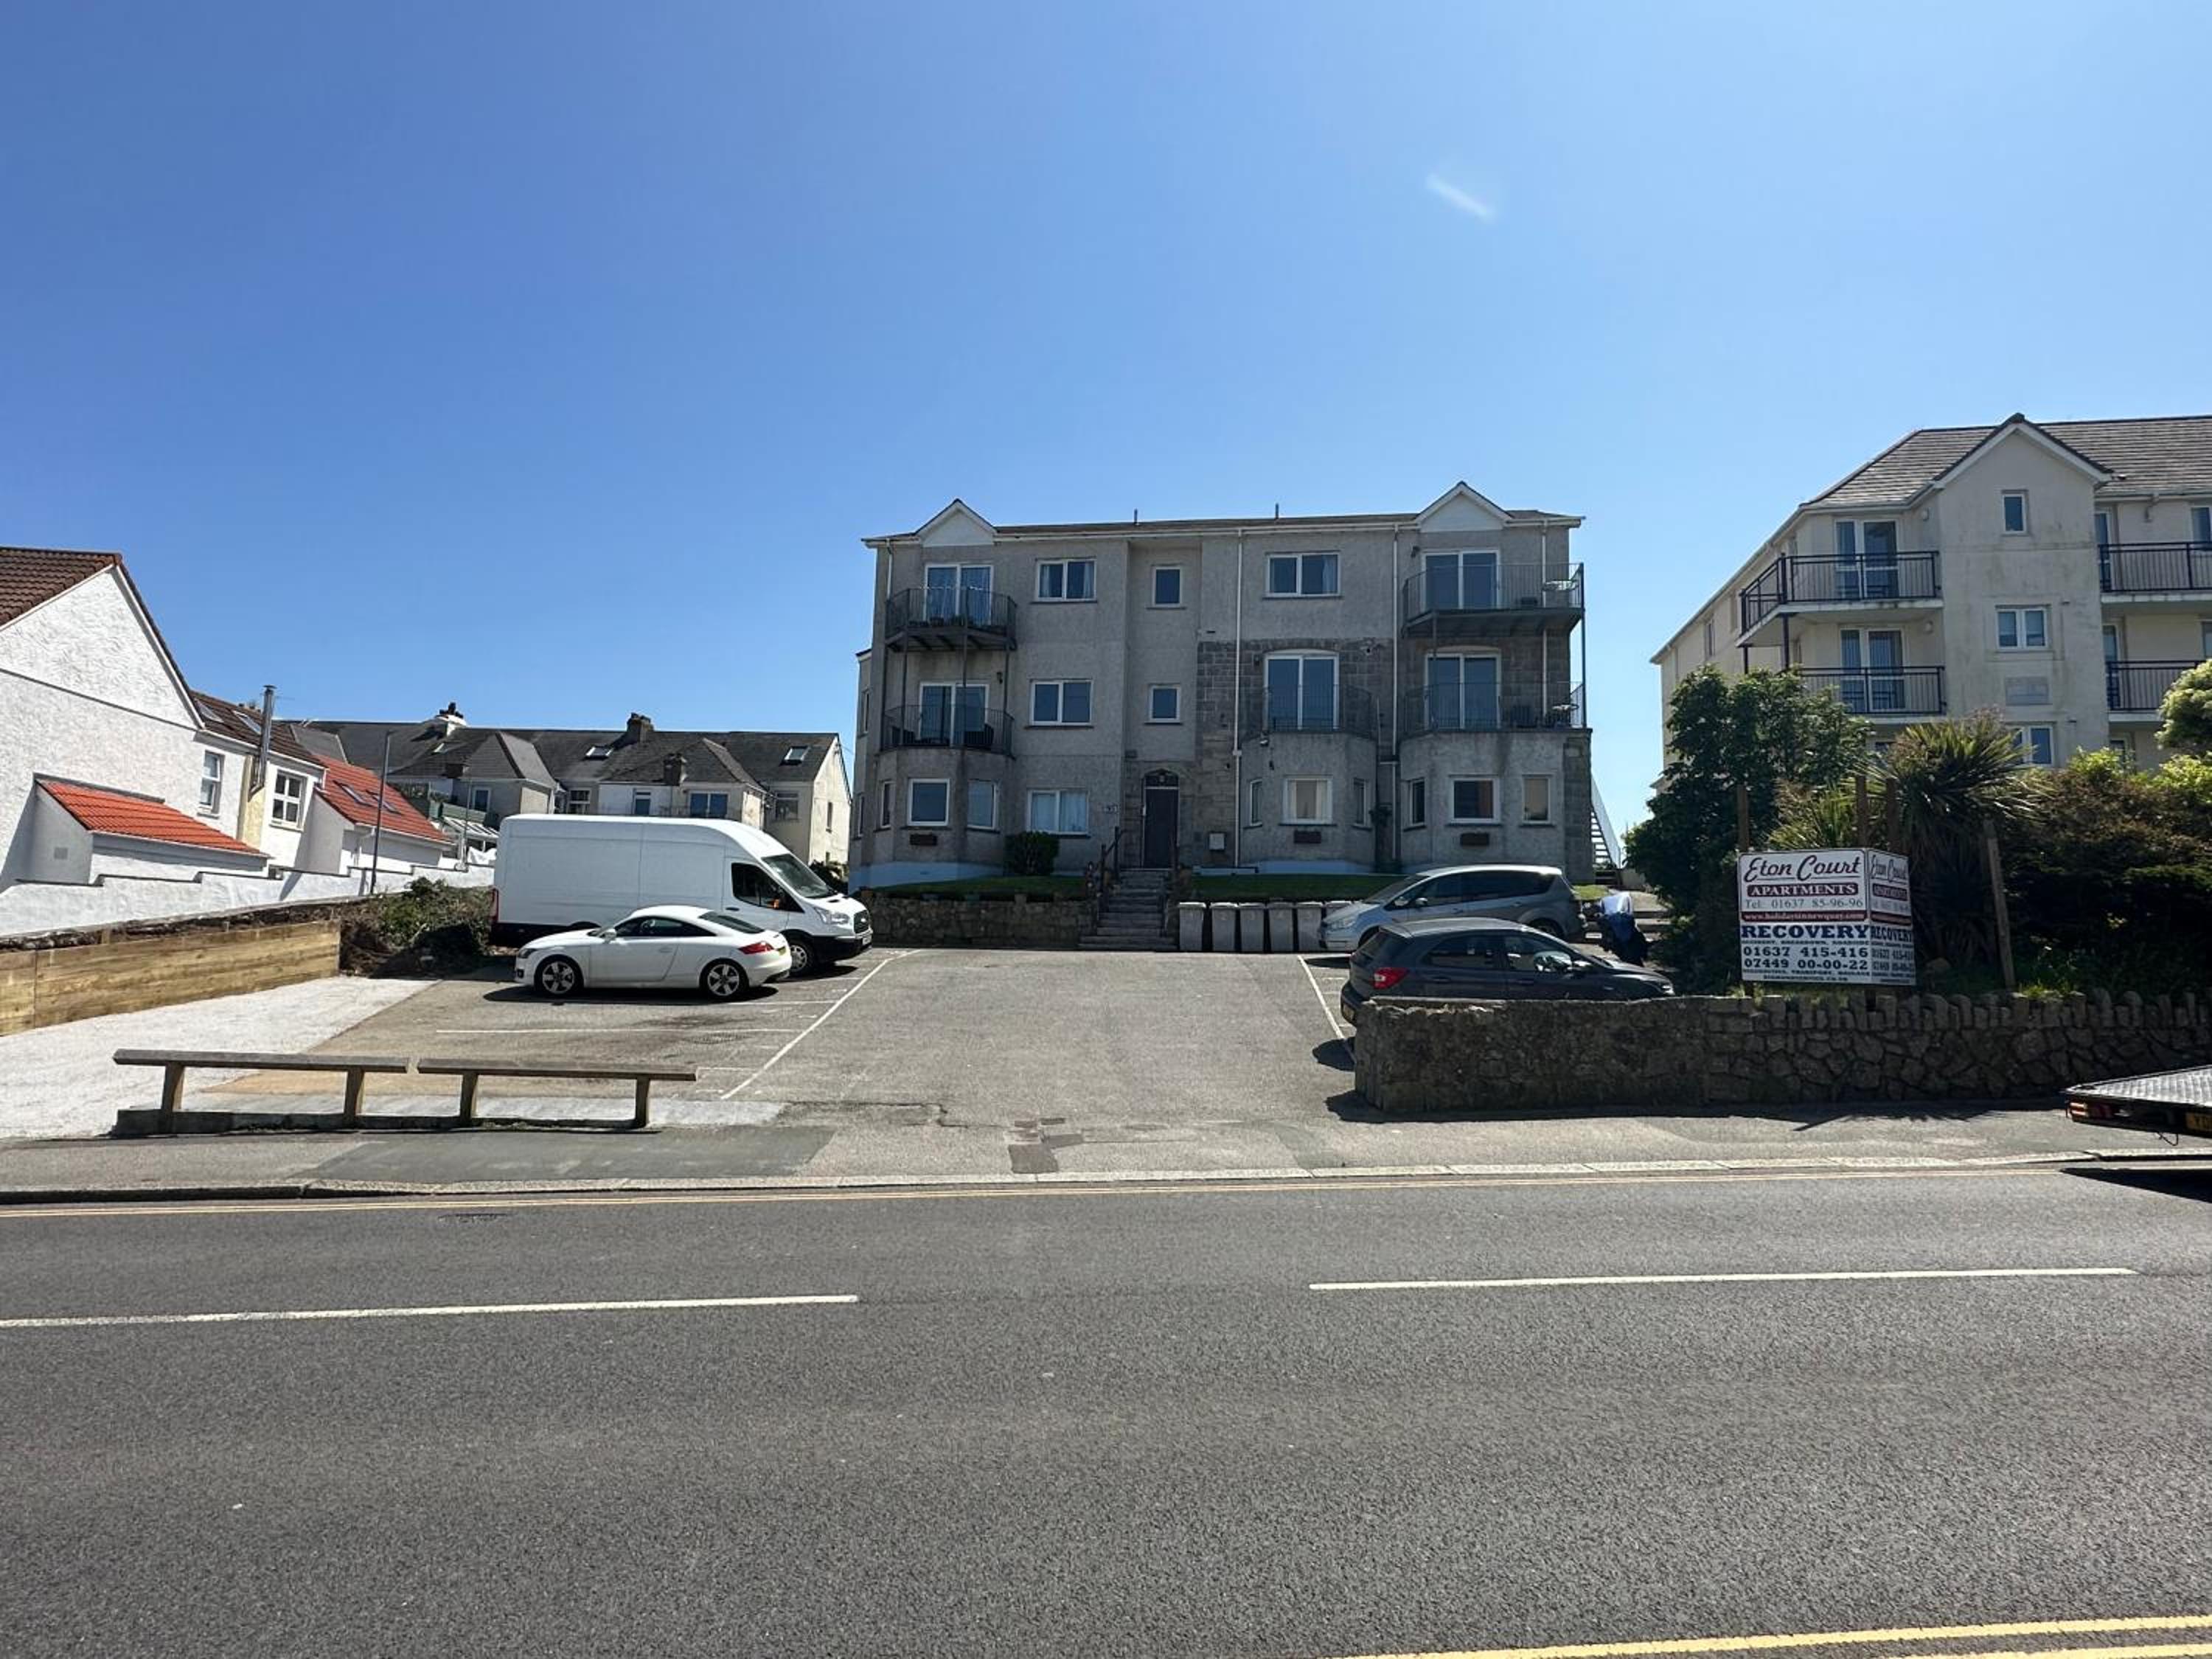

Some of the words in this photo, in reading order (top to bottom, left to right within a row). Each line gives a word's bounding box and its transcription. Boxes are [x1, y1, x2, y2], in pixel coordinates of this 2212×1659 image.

[1744, 858, 1792, 883] Eton
[1796, 855, 1861, 881] Court
[1750, 885, 1856, 896] APARTMENTS
[1770, 898, 1804, 908] 01637
[1812, 897, 1864, 908] 85-96-96
[1741, 925, 1870, 938] RECOVERY
[1743, 947, 1790, 956] 01637
[1800, 947, 1868, 958] 415-416
[1744, 959, 1790, 968] 07449
[1798, 960, 1868, 970] 00-00-22
